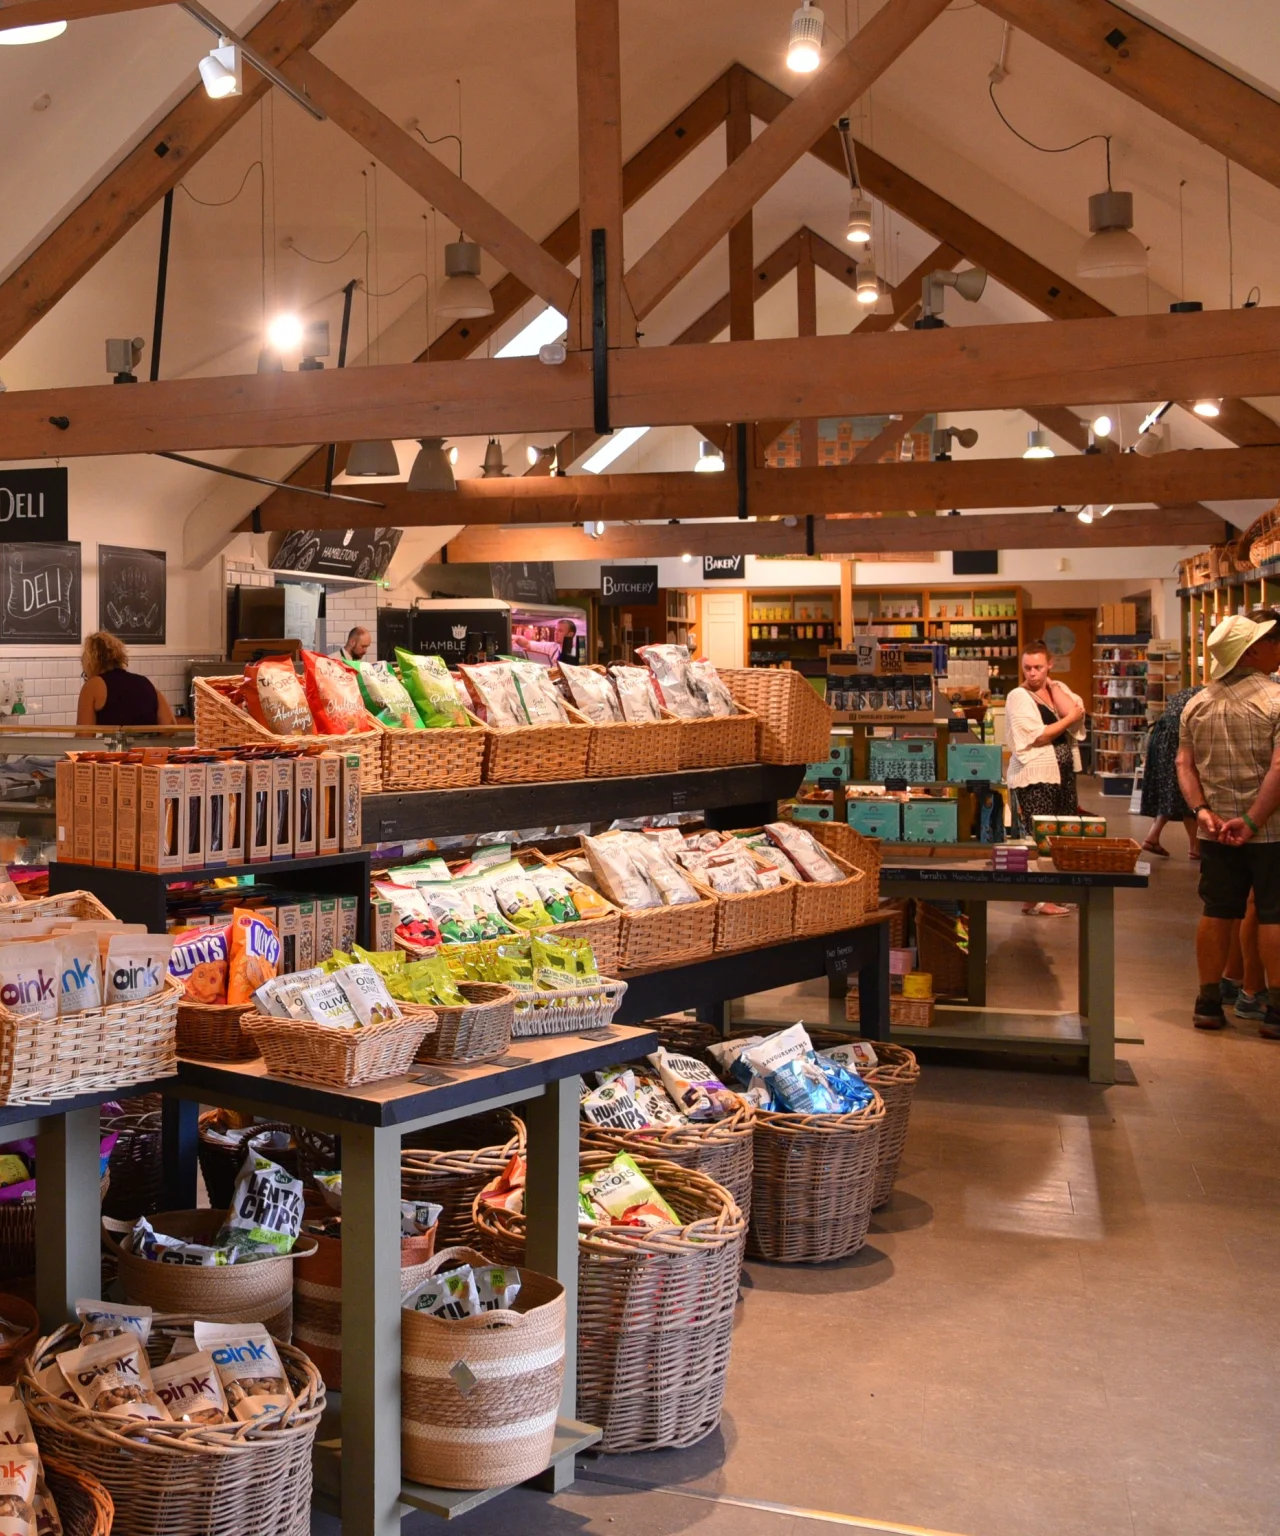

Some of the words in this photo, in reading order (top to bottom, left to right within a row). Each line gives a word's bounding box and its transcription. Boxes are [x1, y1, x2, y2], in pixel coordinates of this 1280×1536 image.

[322, 545, 360, 562] HAMBLETONS
[705, 554, 741, 571] BAKERY
[22, 567, 62, 613] DELI
[603, 576, 654, 596] BUTCHERY
[880, 650, 903, 661] HOT
[880, 660, 903, 668] CHOC
[171, 937, 225, 972] OLLY'S
[0, 968, 56, 1006] oink
[61, 958, 95, 993] nk
[112, 958, 160, 991] oink
[319, 993, 349, 1011] OLIVE
[324, 1004, 350, 1018] SNAC
[668, 1059, 707, 1071] HUMMU
[762, 1040, 808, 1067] SAVOURSMITHS
[591, 1095, 634, 1121] HUMMU
[240, 1195, 298, 1238] CHIPS
[212, 1340, 273, 1366] oink
[77, 1356, 140, 1387] oink
[157, 1376, 216, 1405] oink
